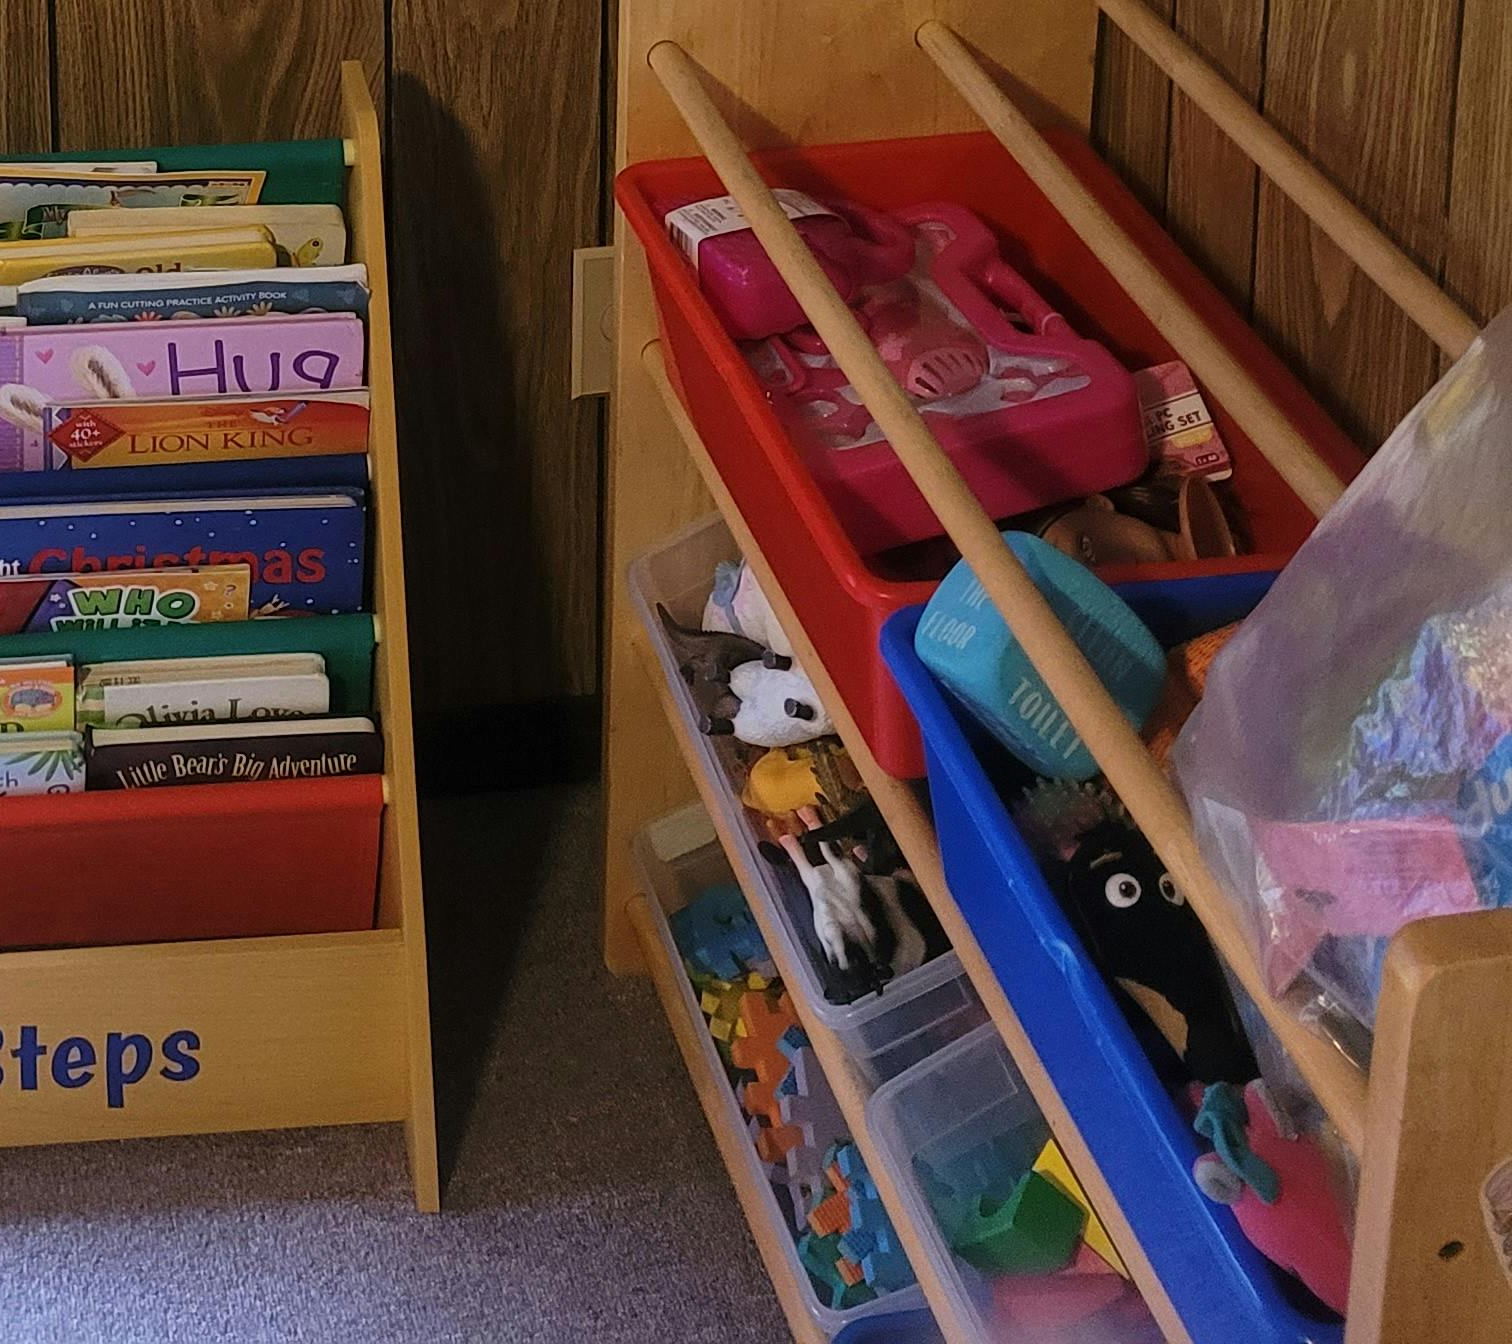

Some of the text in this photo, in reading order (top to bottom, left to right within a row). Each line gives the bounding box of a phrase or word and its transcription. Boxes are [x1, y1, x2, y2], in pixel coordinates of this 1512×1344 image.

[88, 291, 288, 310] A FUN CUTTING PRACTICE ACTIVITY BOOK
[206, 419, 238, 430] THE
[1177, 411, 1202, 427] SET
[70, 428, 101, 441] 40+
[128, 426, 315, 454] LION KING
[72, 588, 196, 619] WHO
[921, 610, 978, 651] FLOOR
[116, 752, 358, 789] Little Bear's Big Adventure
